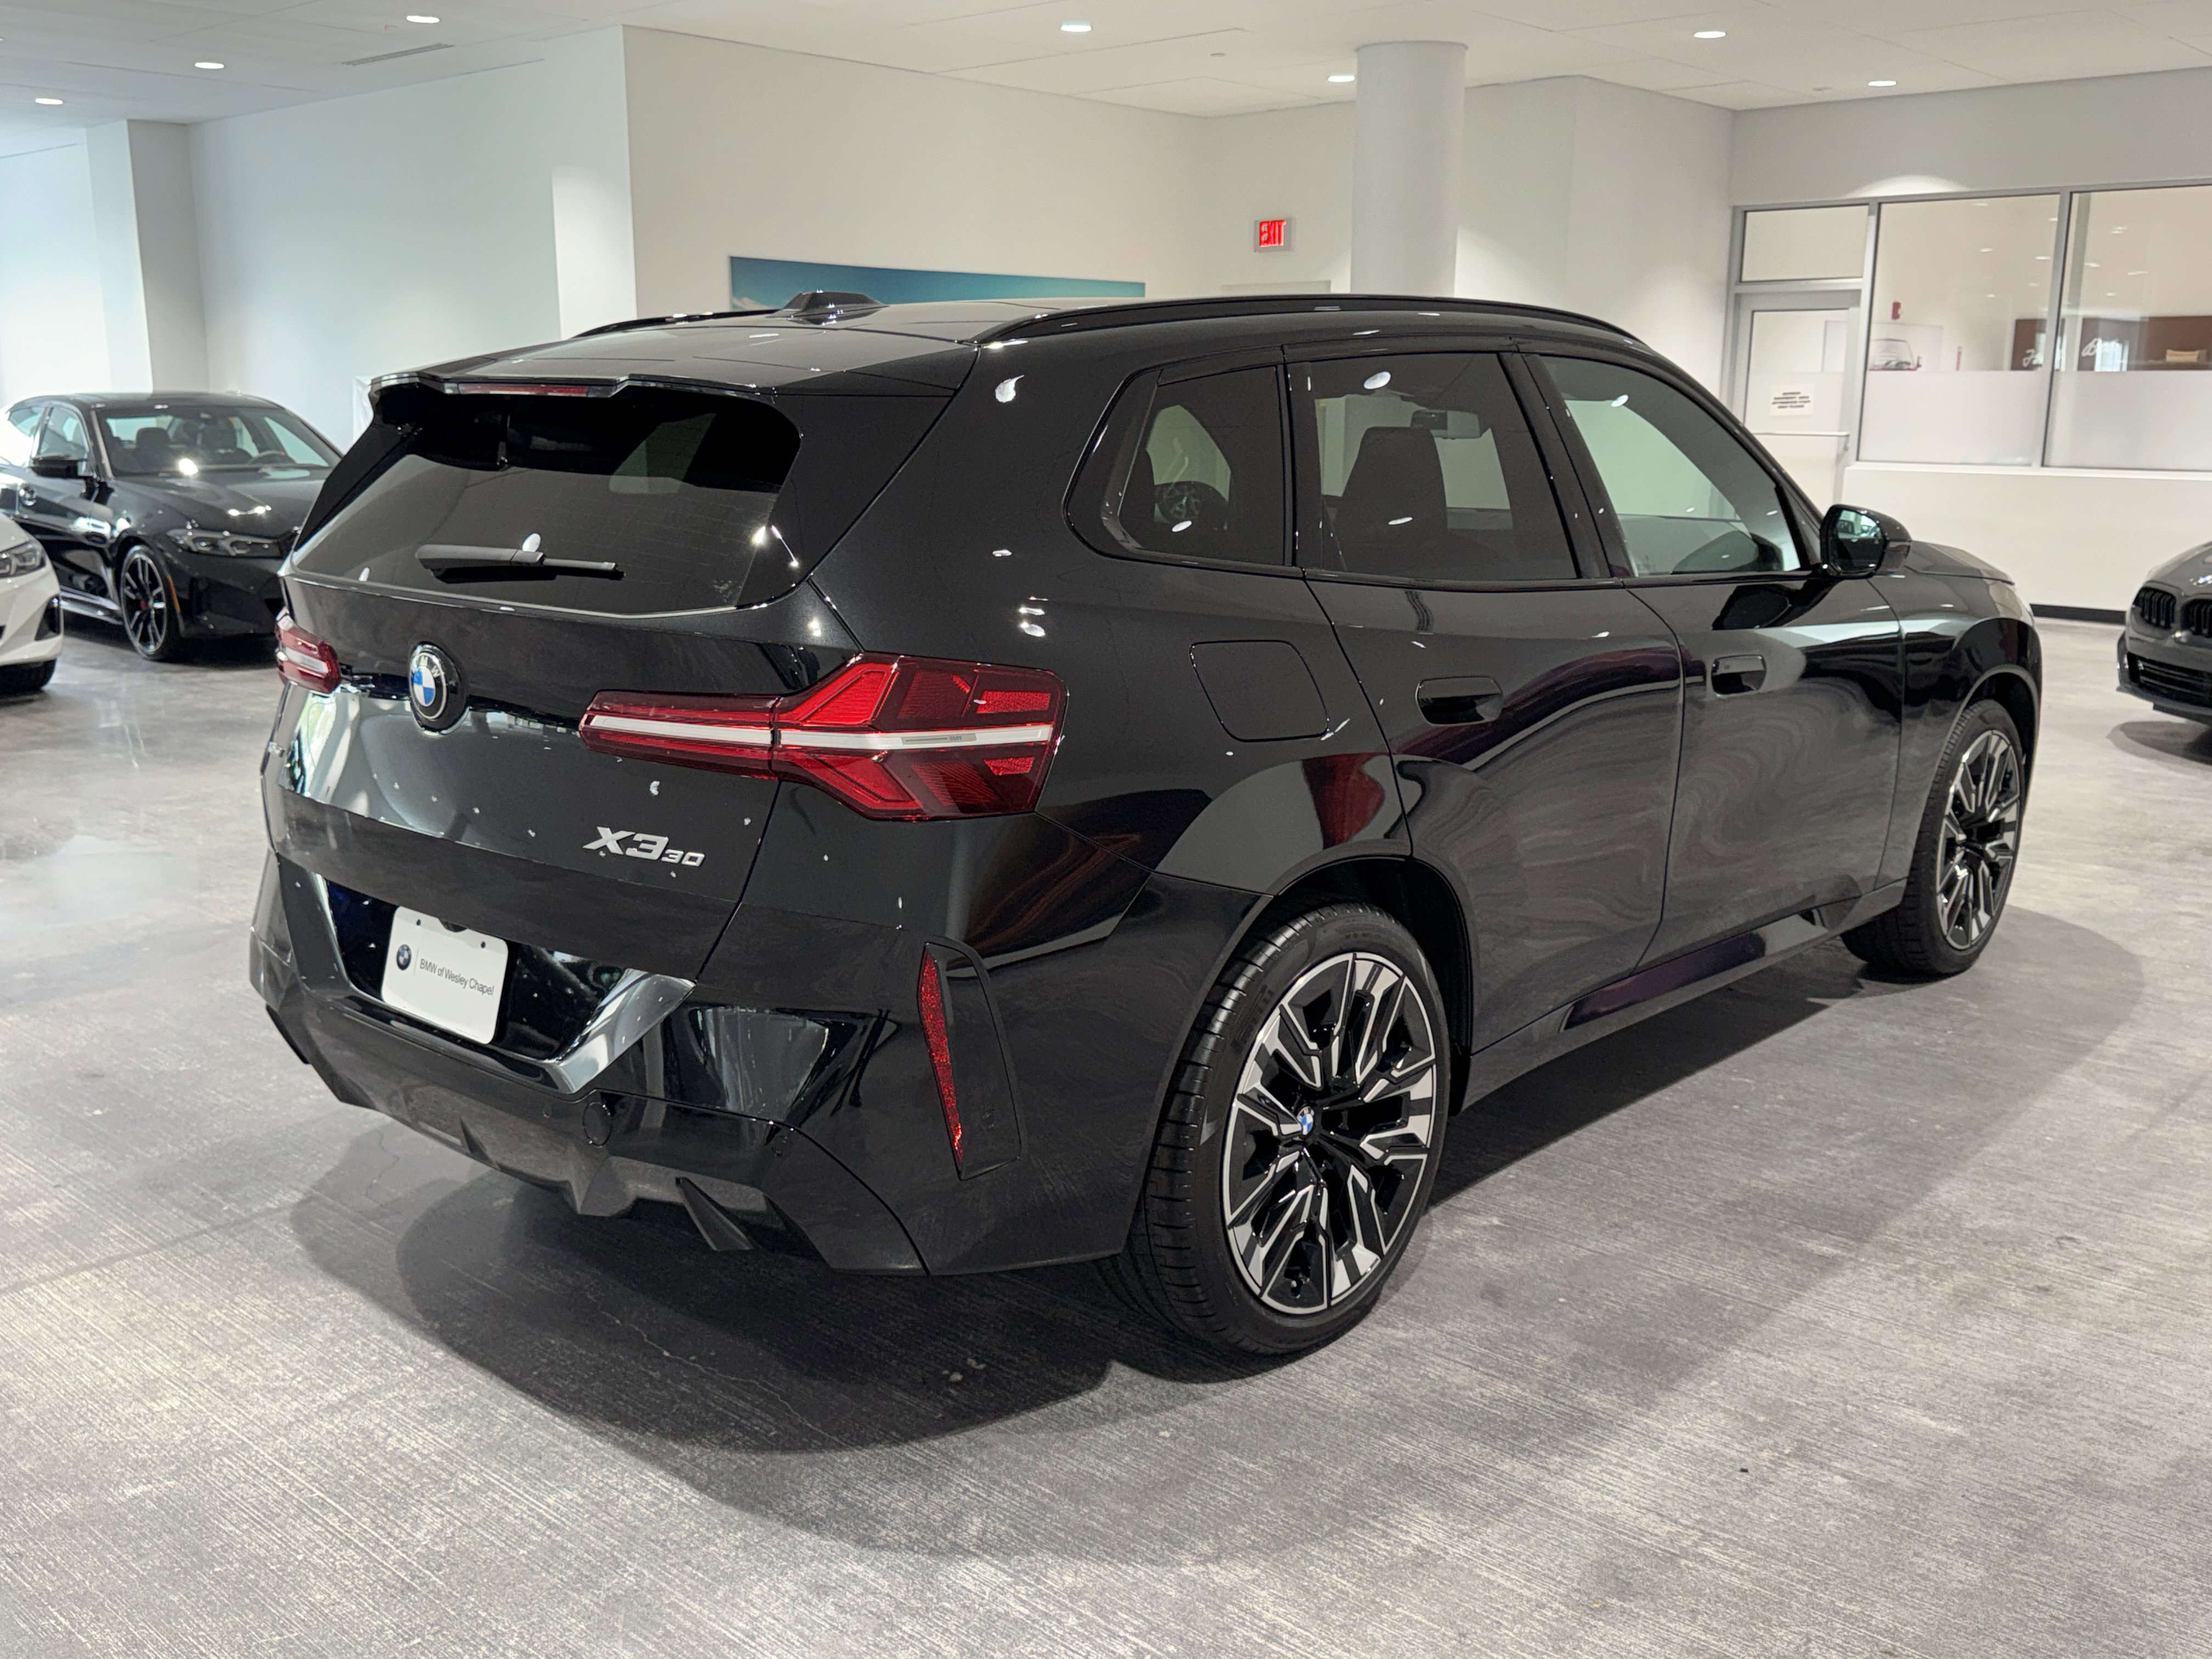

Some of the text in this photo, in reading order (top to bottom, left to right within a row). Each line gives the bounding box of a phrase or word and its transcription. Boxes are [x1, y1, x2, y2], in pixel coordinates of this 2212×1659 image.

[1259, 219, 1286, 247] EXIT
[420, 958, 495, 996] BMW of Wesley Chapel
